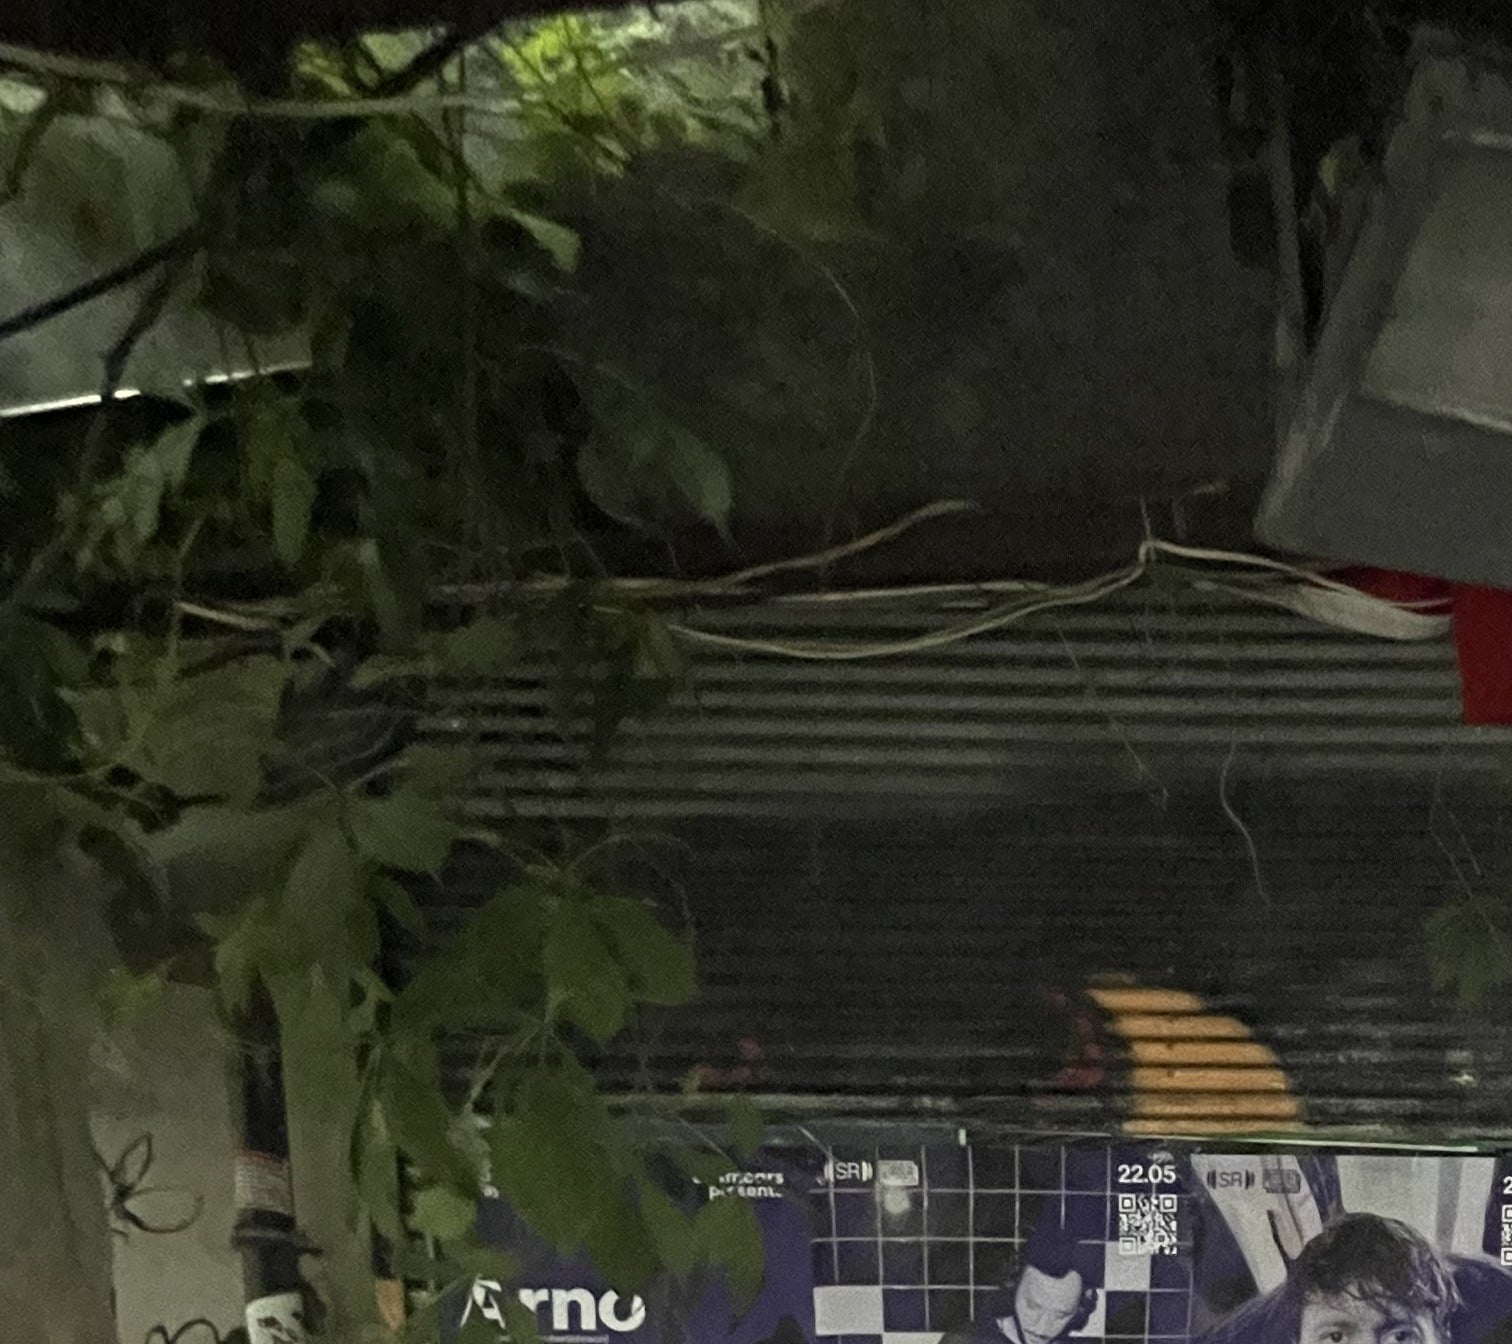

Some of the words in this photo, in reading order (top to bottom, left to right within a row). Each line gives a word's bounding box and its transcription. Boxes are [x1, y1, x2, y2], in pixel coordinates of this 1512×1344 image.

[836, 1162, 862, 1180] SR
[1118, 1165, 1176, 1184] 22.05
[1218, 1171, 1244, 1188] SR
